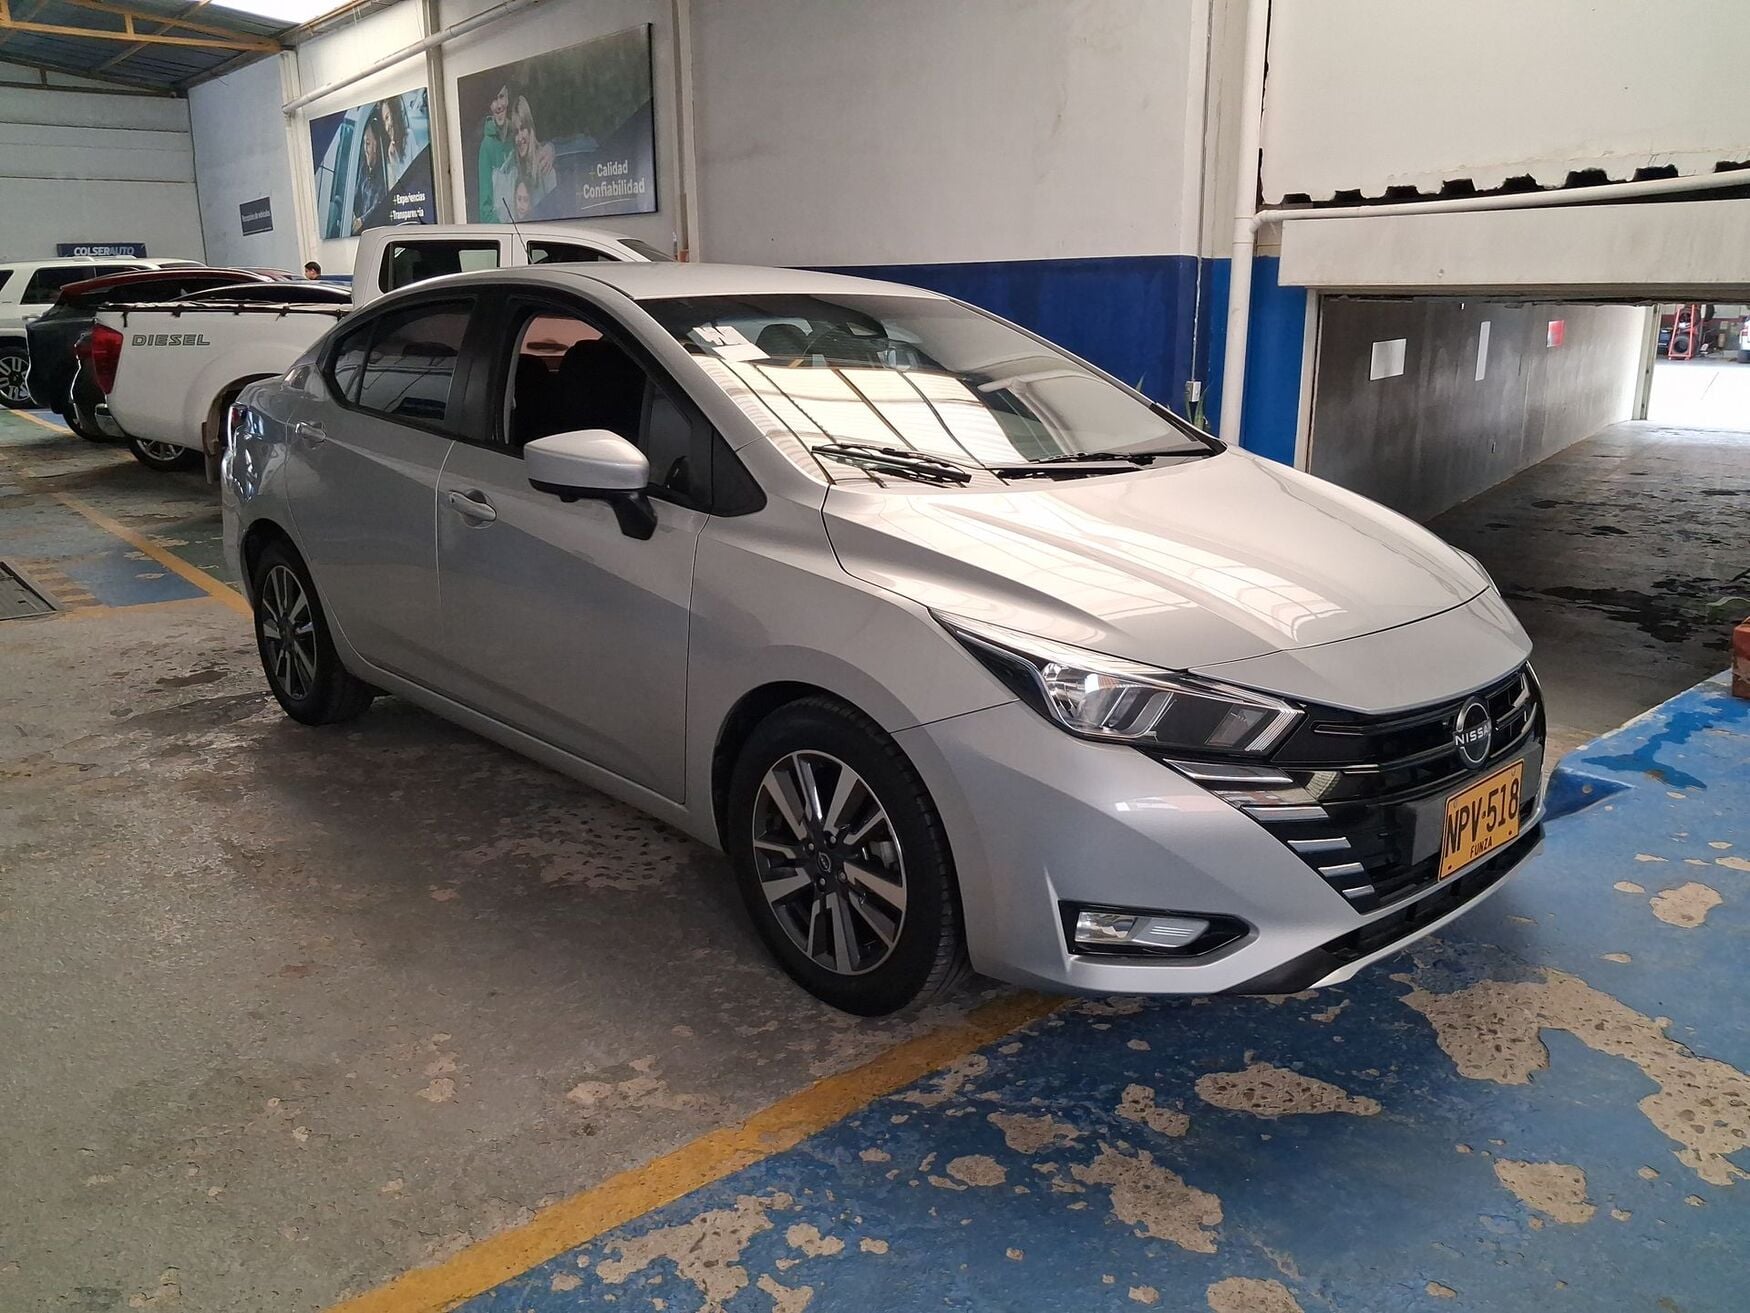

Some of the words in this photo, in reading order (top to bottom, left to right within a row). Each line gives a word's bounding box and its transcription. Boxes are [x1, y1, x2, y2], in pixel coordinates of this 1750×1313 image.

[74, 246, 135, 256] COLSERAUTO
[132, 334, 210, 346] DIESEL
[1470, 836, 1493, 858] FUNZA
